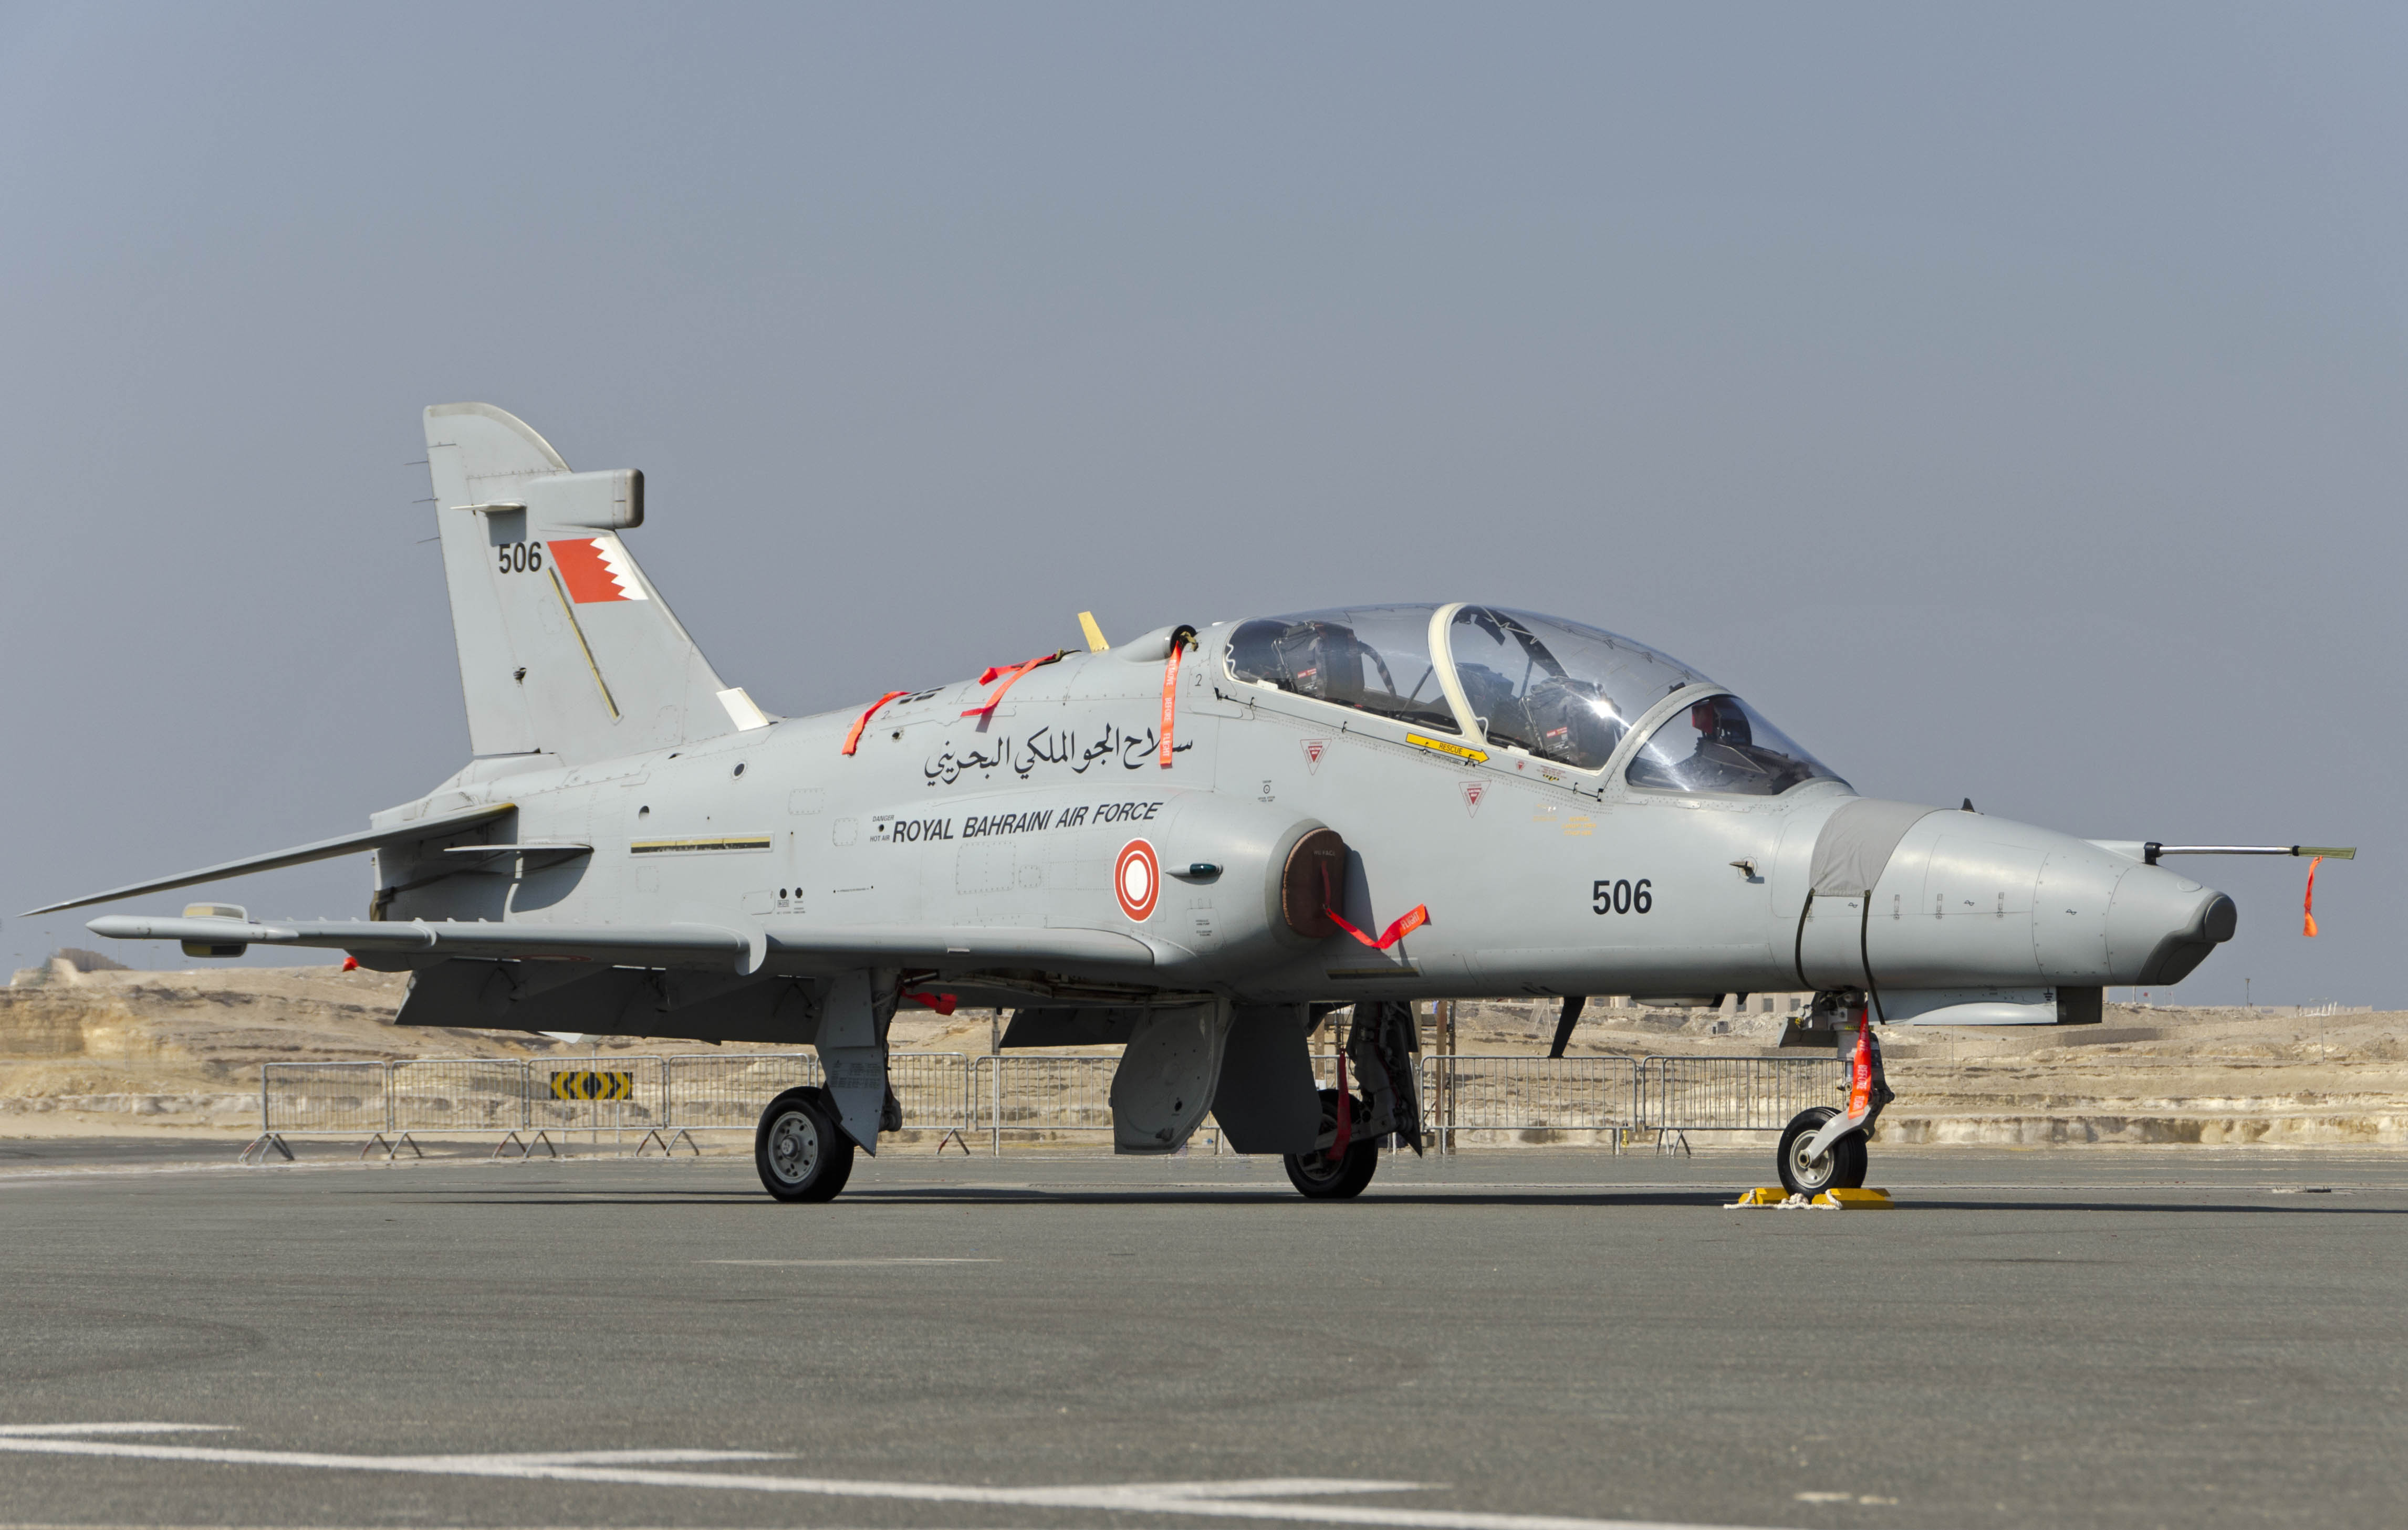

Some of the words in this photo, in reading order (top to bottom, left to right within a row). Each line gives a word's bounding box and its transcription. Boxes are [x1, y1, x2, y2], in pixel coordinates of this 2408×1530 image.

[498, 542, 541, 574] 506
[1194, 674, 1202, 687] 2
[881, 710, 890, 720] 2
[1163, 697, 1172, 722] BEFORE
[1014, 726, 1075, 780] الملكي
[1072, 722, 1120, 774] الجو
[1162, 732, 1171, 757] FLIGHT
[1439, 743, 1463, 754] RESCUE
[924, 737, 1010, 787] البحريني
[893, 819, 954, 843] ROYAL
[963, 810, 1052, 838] BAHRAINI
[1056, 806, 1089, 828] AIR
[1092, 802, 1164, 824] FORCE
[1592, 878, 1652, 915] 506
[1400, 911, 1420, 930] FLIGHT
[1857, 1064, 1869, 1090] BEFORE
